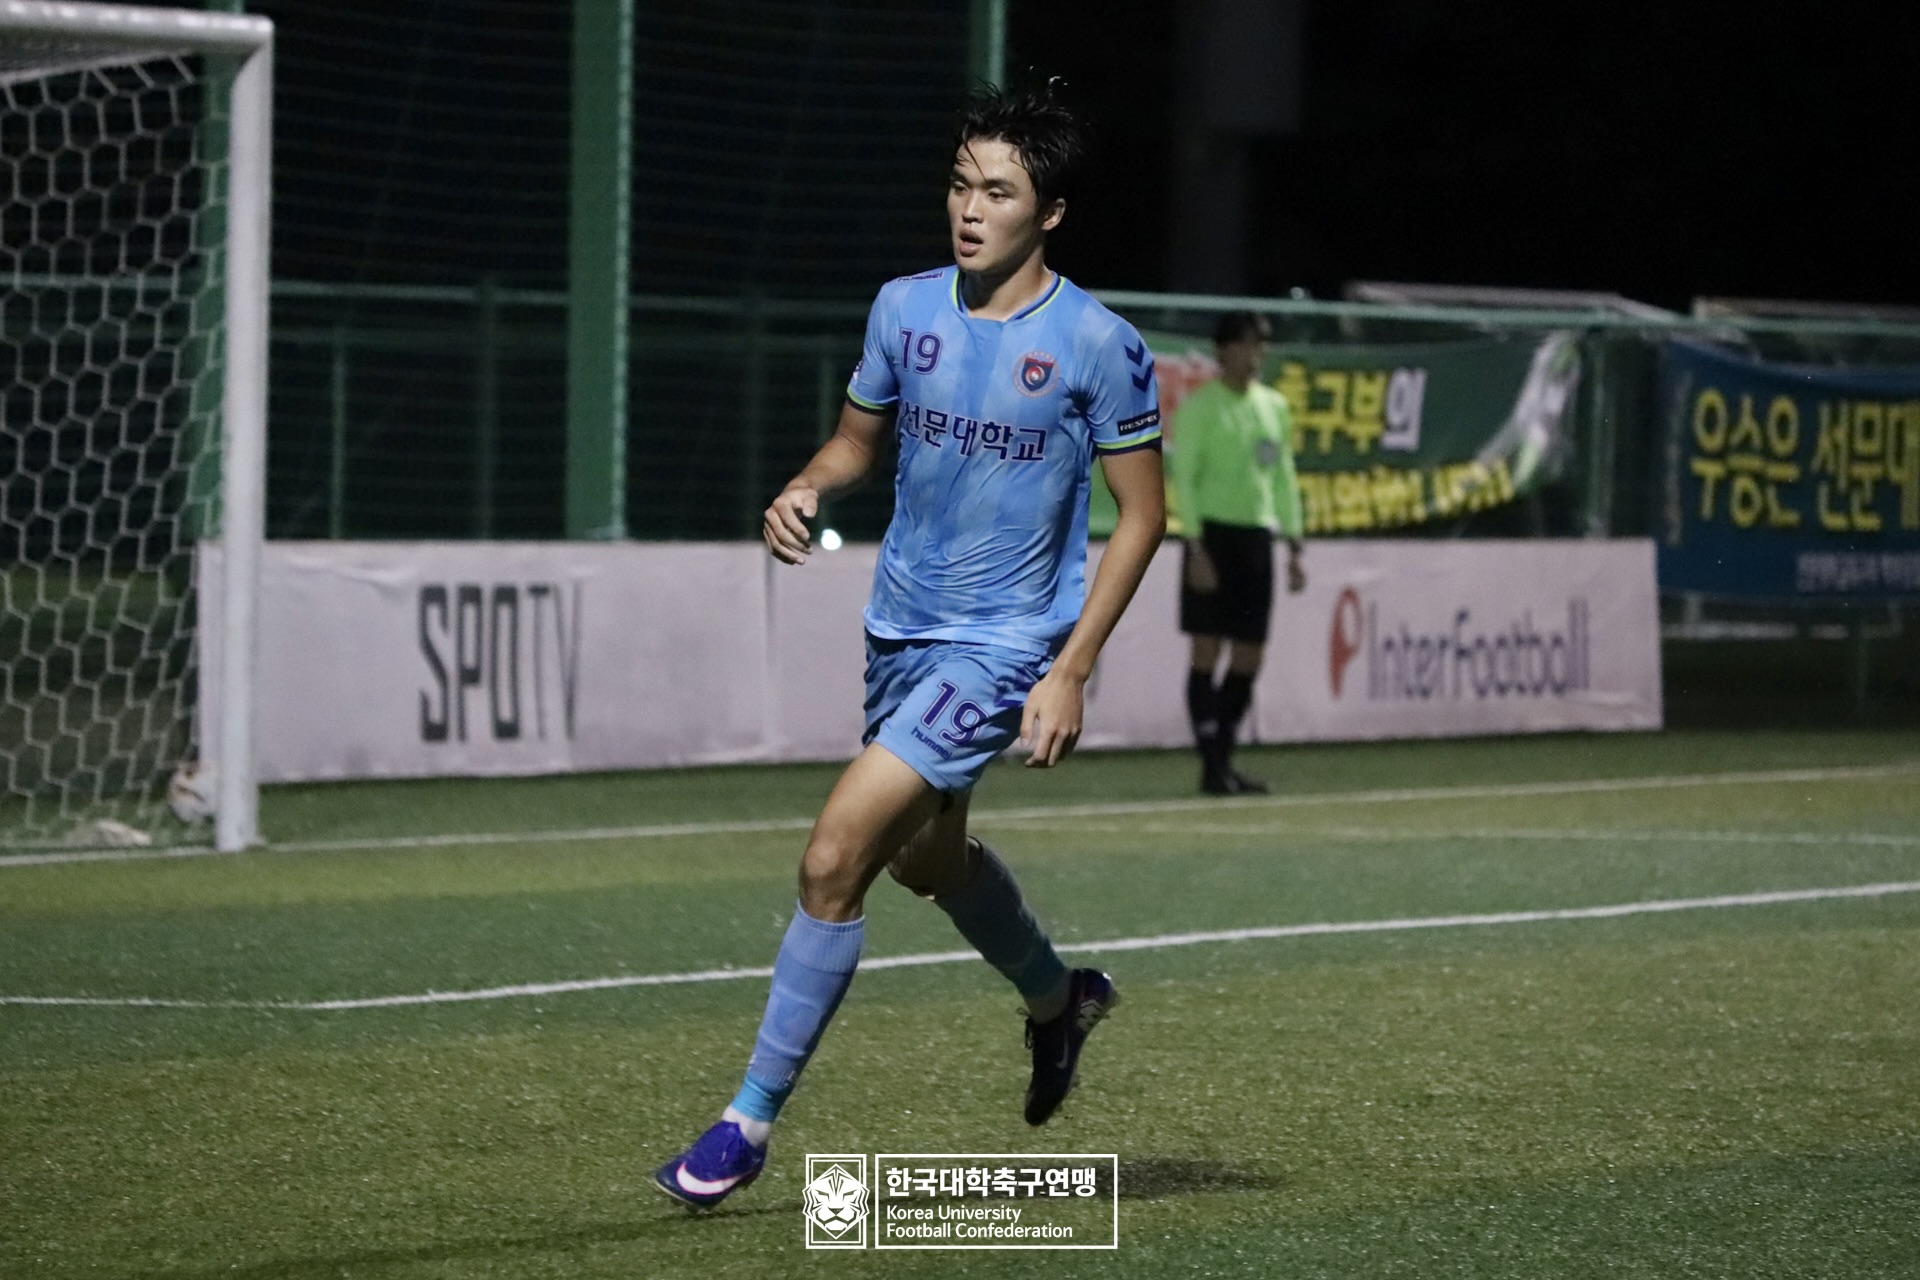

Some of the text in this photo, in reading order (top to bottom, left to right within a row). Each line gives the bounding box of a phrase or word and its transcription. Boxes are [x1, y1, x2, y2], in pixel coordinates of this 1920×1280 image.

[900, 327, 942, 375] 19
[900, 401, 1047, 461] 선문대학교
[1120, 414, 1158, 431] RESPEC
[1690, 388, 1801, 528] 우승은
[418, 583, 582, 742] SPOTV
[921, 679, 989, 747] 19
[911, 727, 952, 760] hummel
